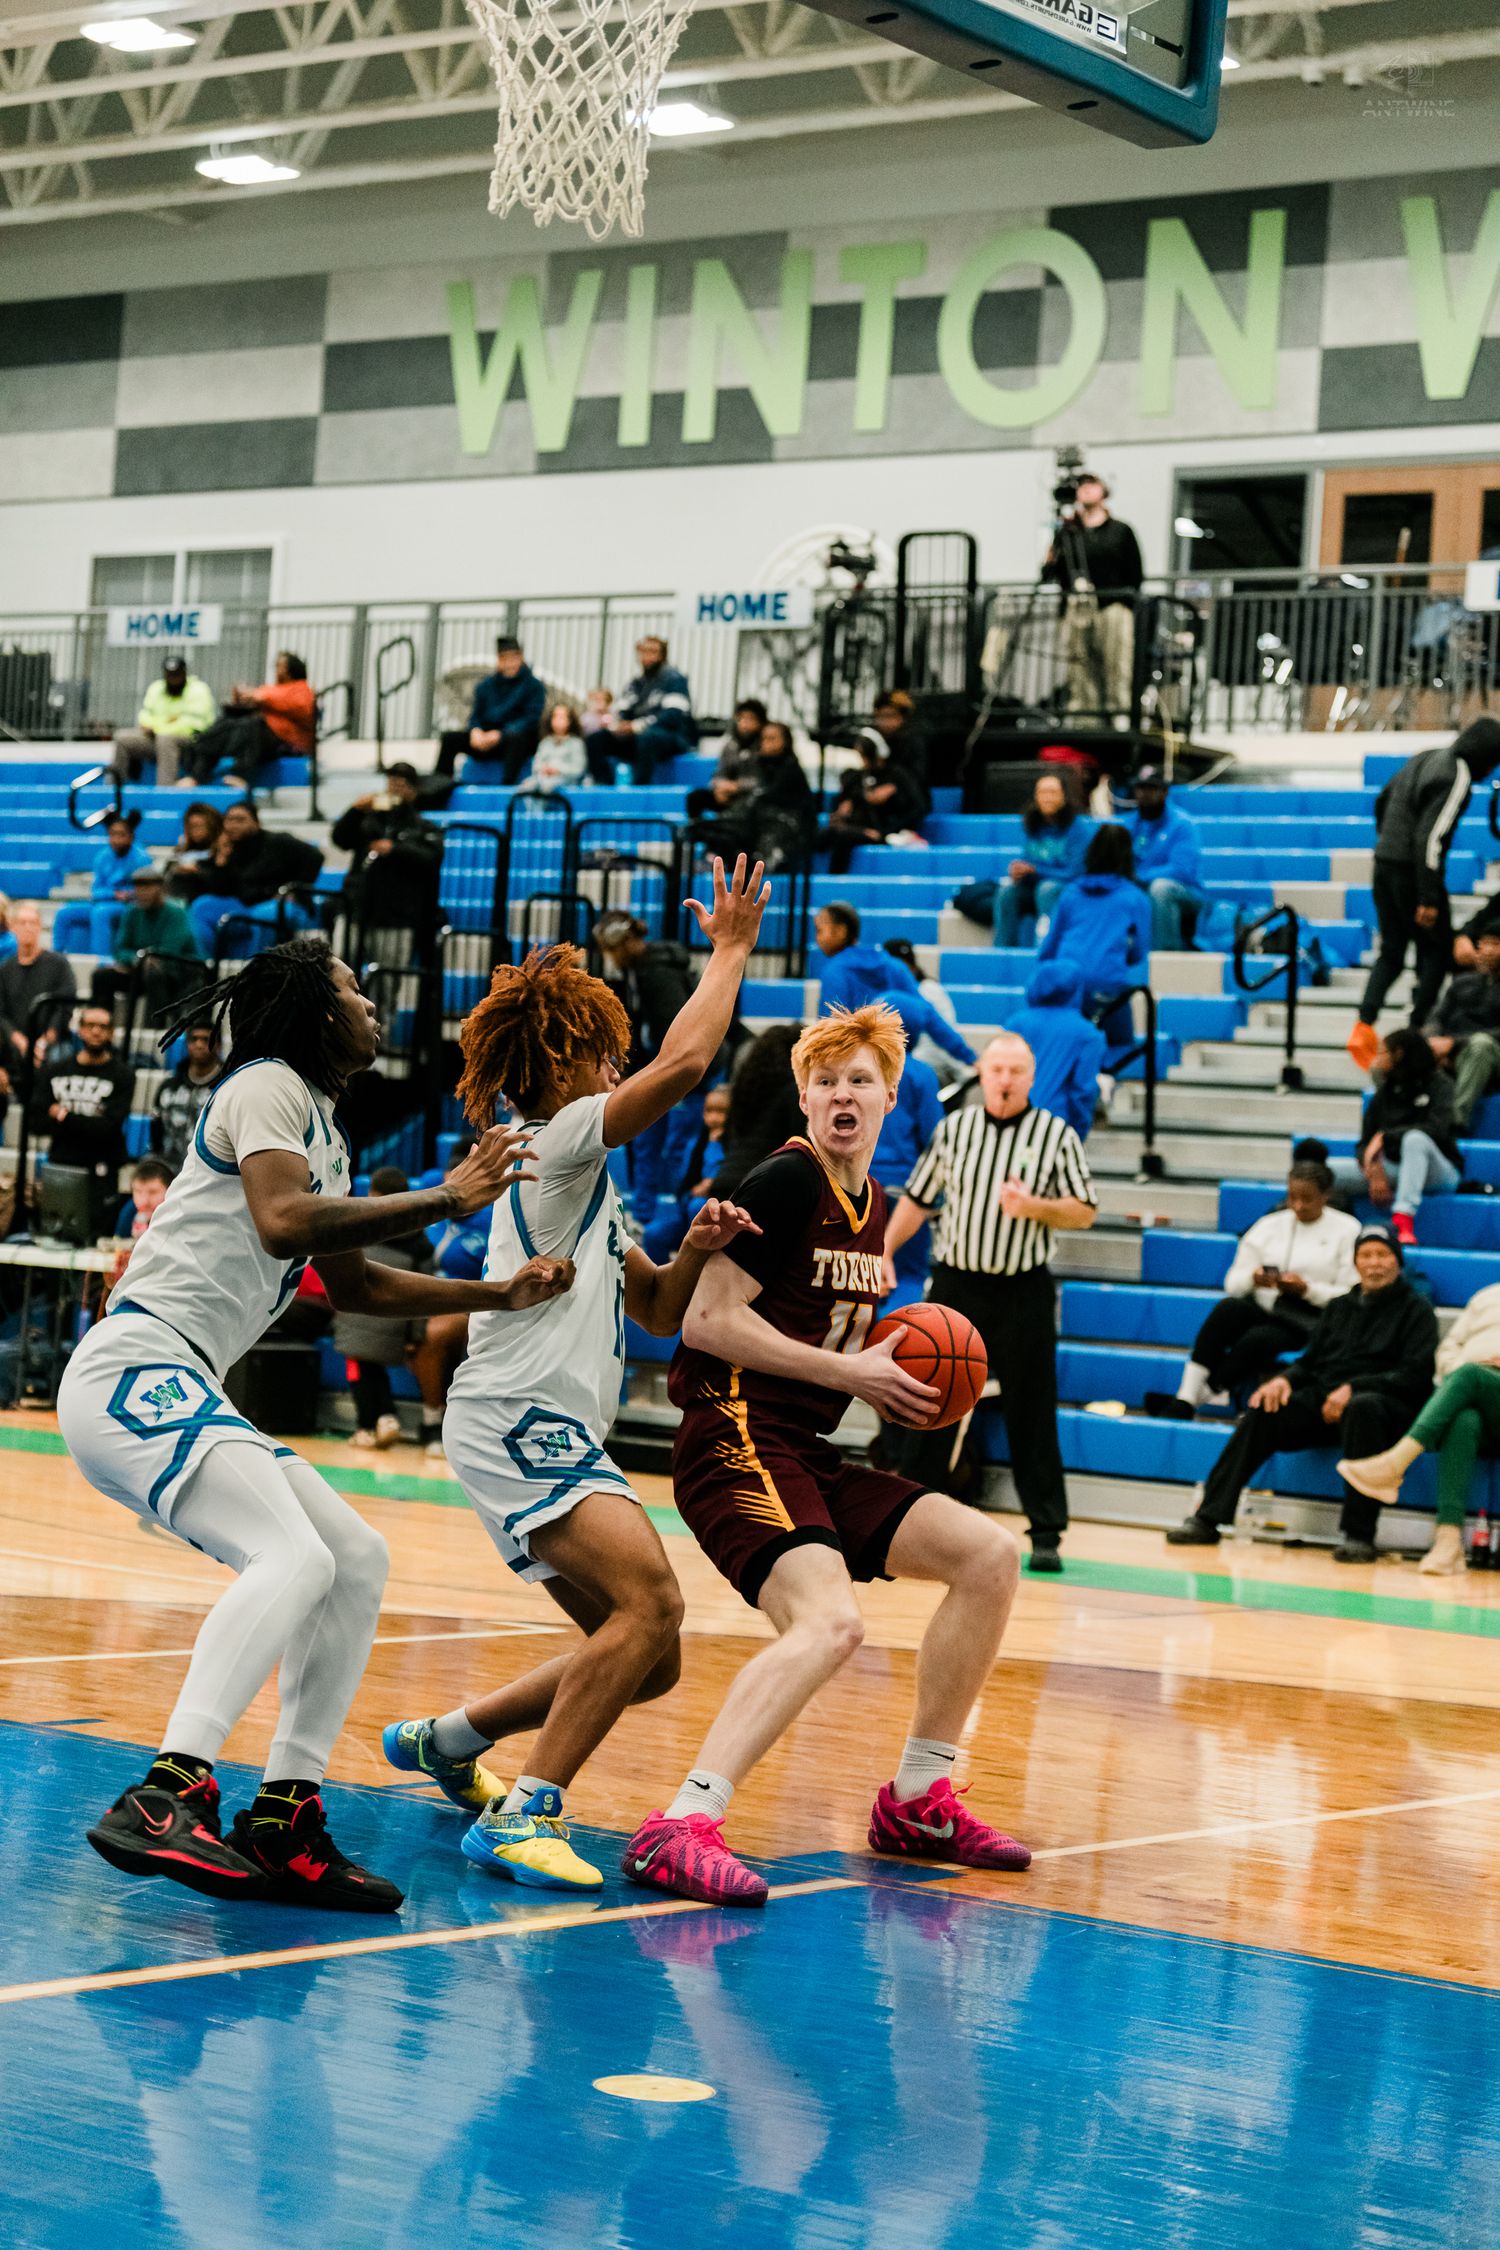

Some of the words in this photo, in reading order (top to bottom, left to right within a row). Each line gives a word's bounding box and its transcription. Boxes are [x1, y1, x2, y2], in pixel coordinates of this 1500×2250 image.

[447, 208, 1287, 456] WINTON
[126, 611, 200, 638] HOME
[697, 592, 788, 622] HOME
[821, 1300, 873, 1356] 11
